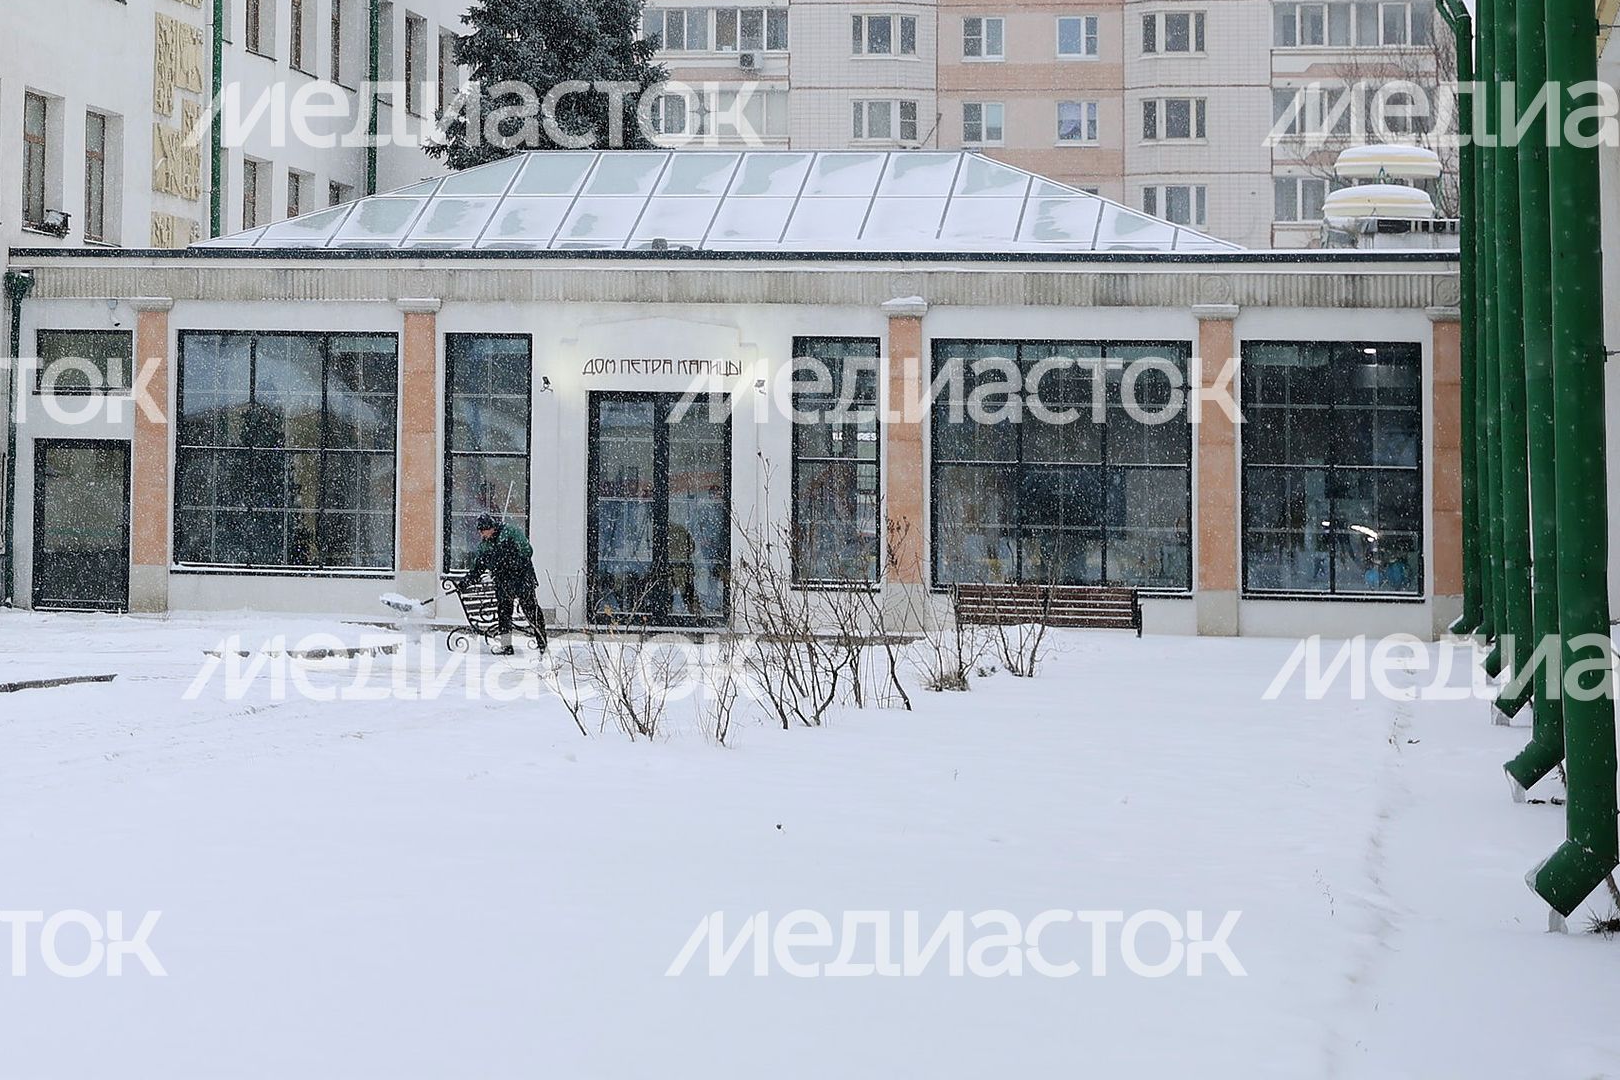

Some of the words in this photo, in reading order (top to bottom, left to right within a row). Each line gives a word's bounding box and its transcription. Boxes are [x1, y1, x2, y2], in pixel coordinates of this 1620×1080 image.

[583, 358, 617, 376] ДОМ
[620, 358, 673, 376] ПЕТРА
[677, 358, 742, 377] КАПИЦЫ
